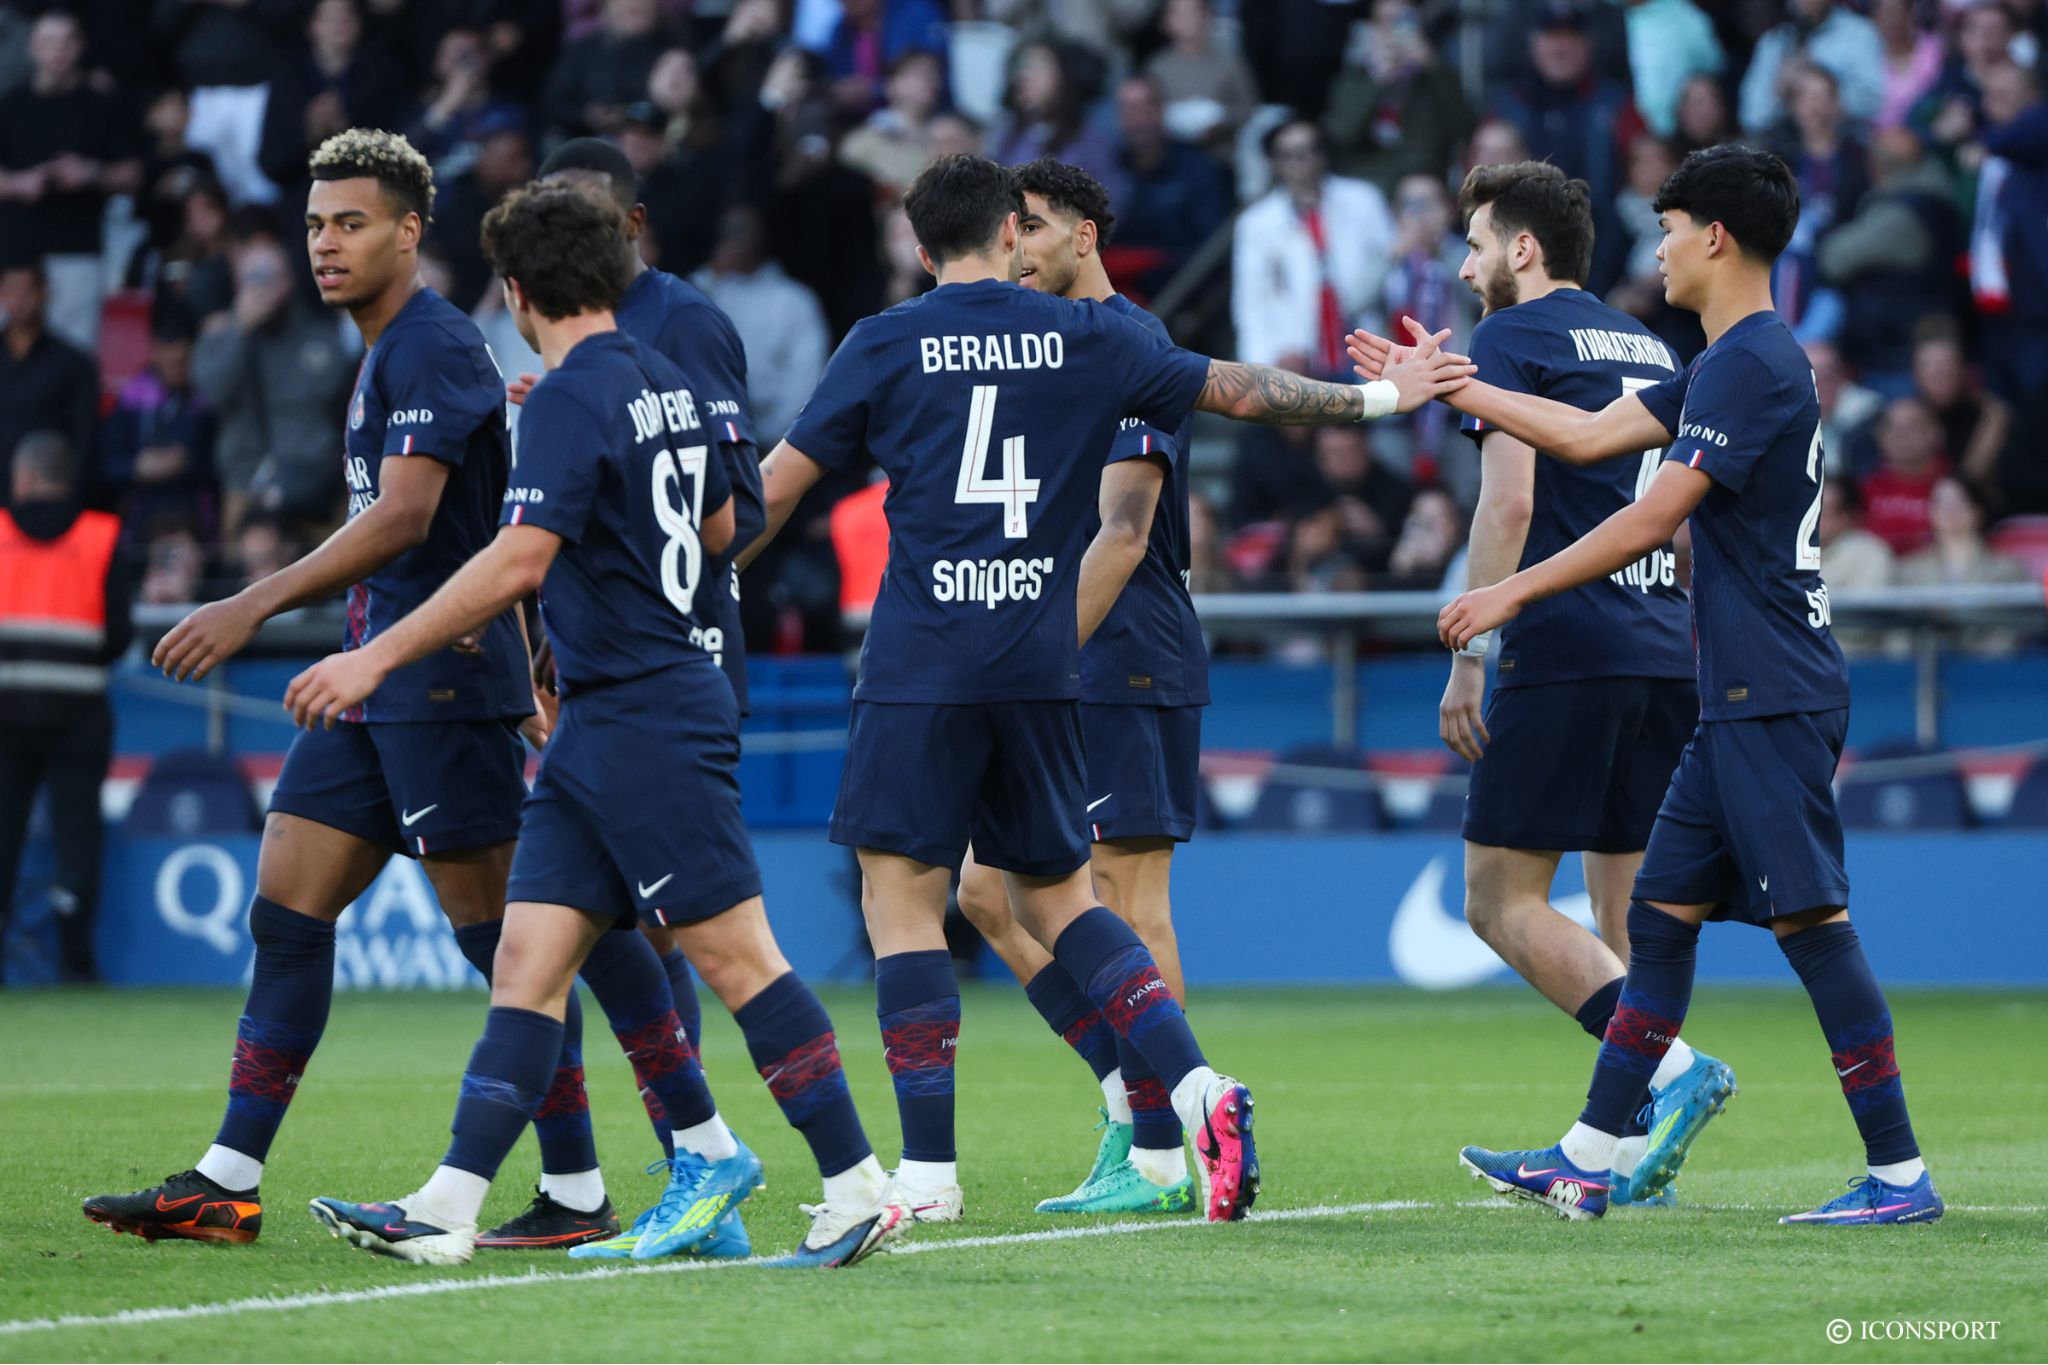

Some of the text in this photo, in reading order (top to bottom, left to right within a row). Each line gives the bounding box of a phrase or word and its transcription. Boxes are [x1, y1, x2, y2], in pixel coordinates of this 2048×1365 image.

[920, 332, 1064, 373] BERALDO
[387, 409, 433, 429] OND
[954, 385, 1040, 538] 4
[651, 446, 707, 616] 87
[1127, 979, 1166, 1007] PARIS
